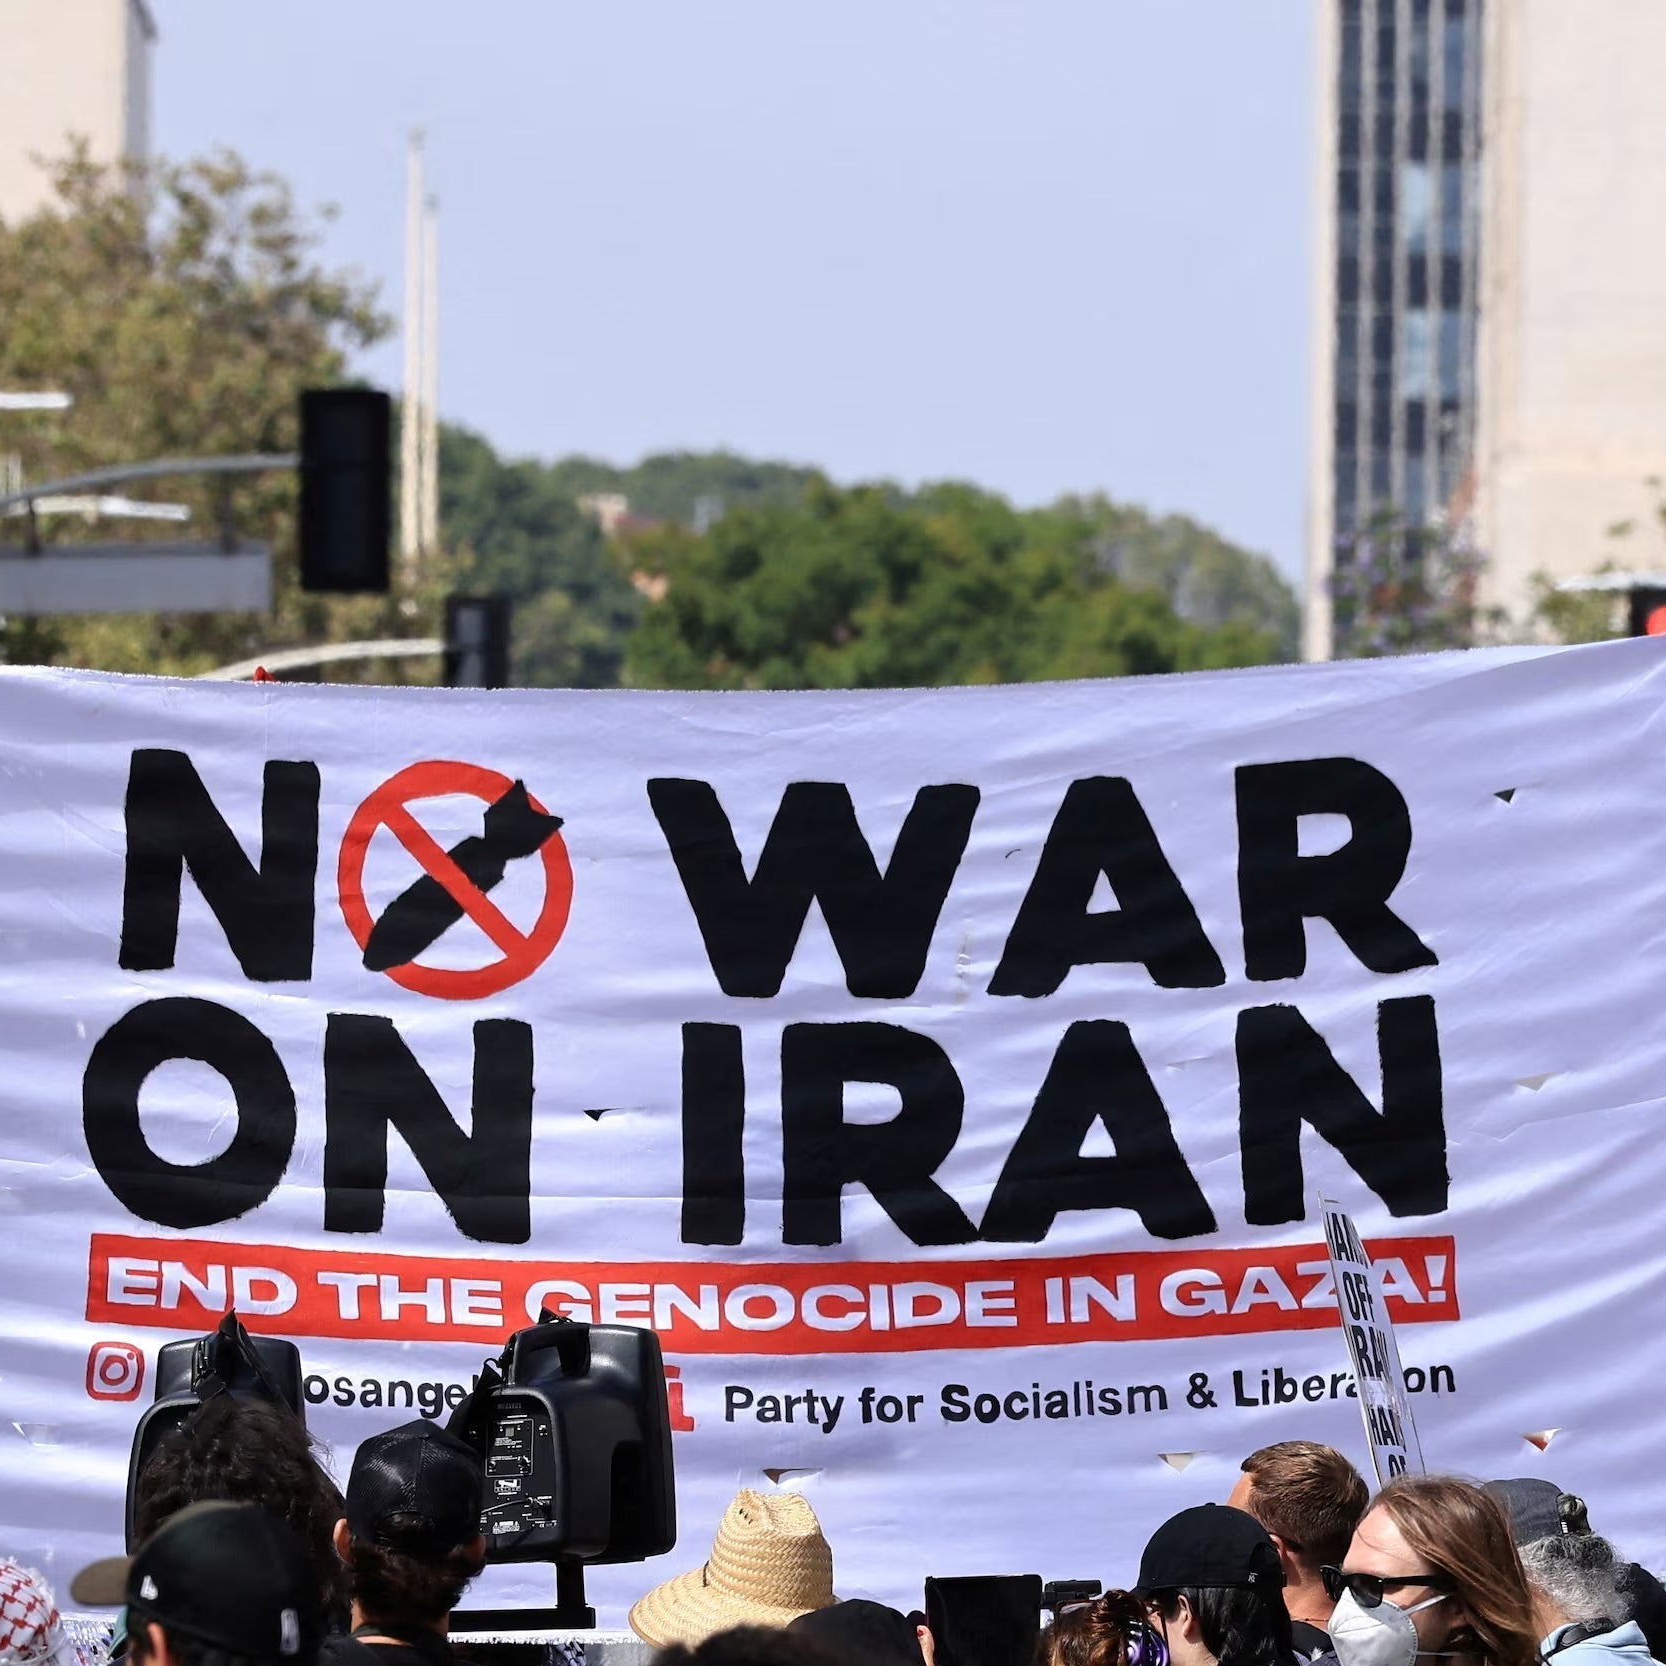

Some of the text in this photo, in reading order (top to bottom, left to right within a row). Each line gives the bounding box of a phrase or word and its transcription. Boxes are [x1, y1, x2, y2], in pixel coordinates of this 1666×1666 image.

[647, 757, 1439, 999] WAR
[83, 994, 1449, 1245] ON IRAN
[106, 1254, 1449, 1334] END THE GENOCIDE IN GAZA!
[725, 1384, 841, 1434] Party
[860, 1387, 924, 1425] for
[939, 1373, 1169, 1424] Socialism
[1186, 1371, 1217, 1410] &
[1232, 1361, 1457, 1407] Liberaon
